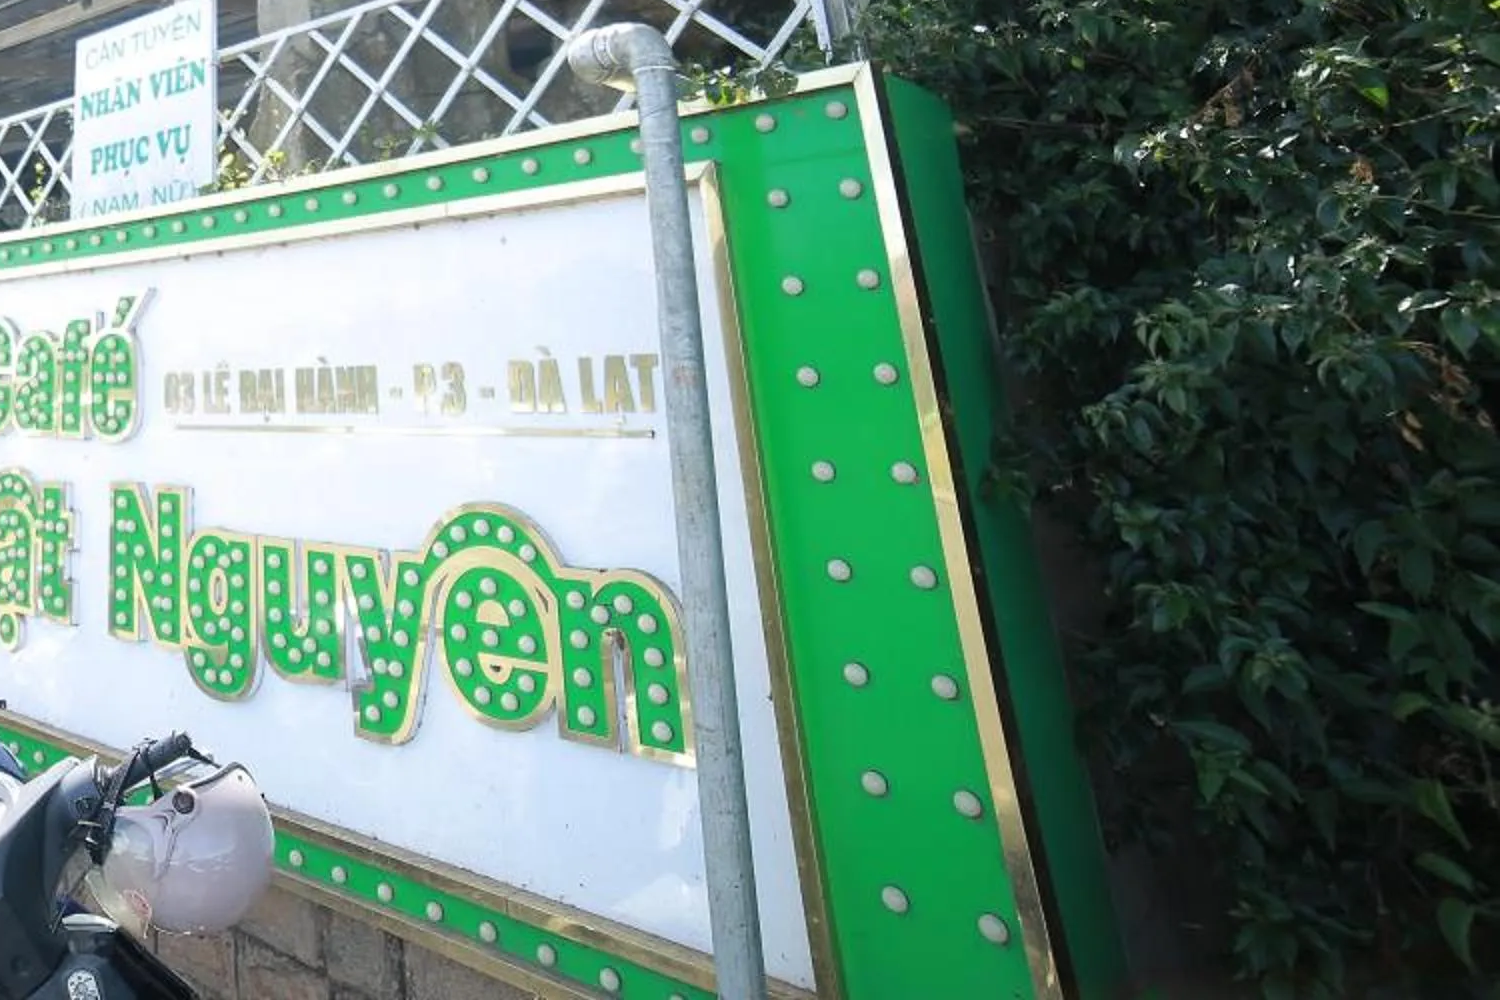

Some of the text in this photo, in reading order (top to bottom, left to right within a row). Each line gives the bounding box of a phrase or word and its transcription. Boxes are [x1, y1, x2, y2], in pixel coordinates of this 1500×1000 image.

[150, 56, 206, 100] VIÊN
[90, 124, 191, 176] PHỤC VỤ
[107, 480, 697, 770] Nguyên
